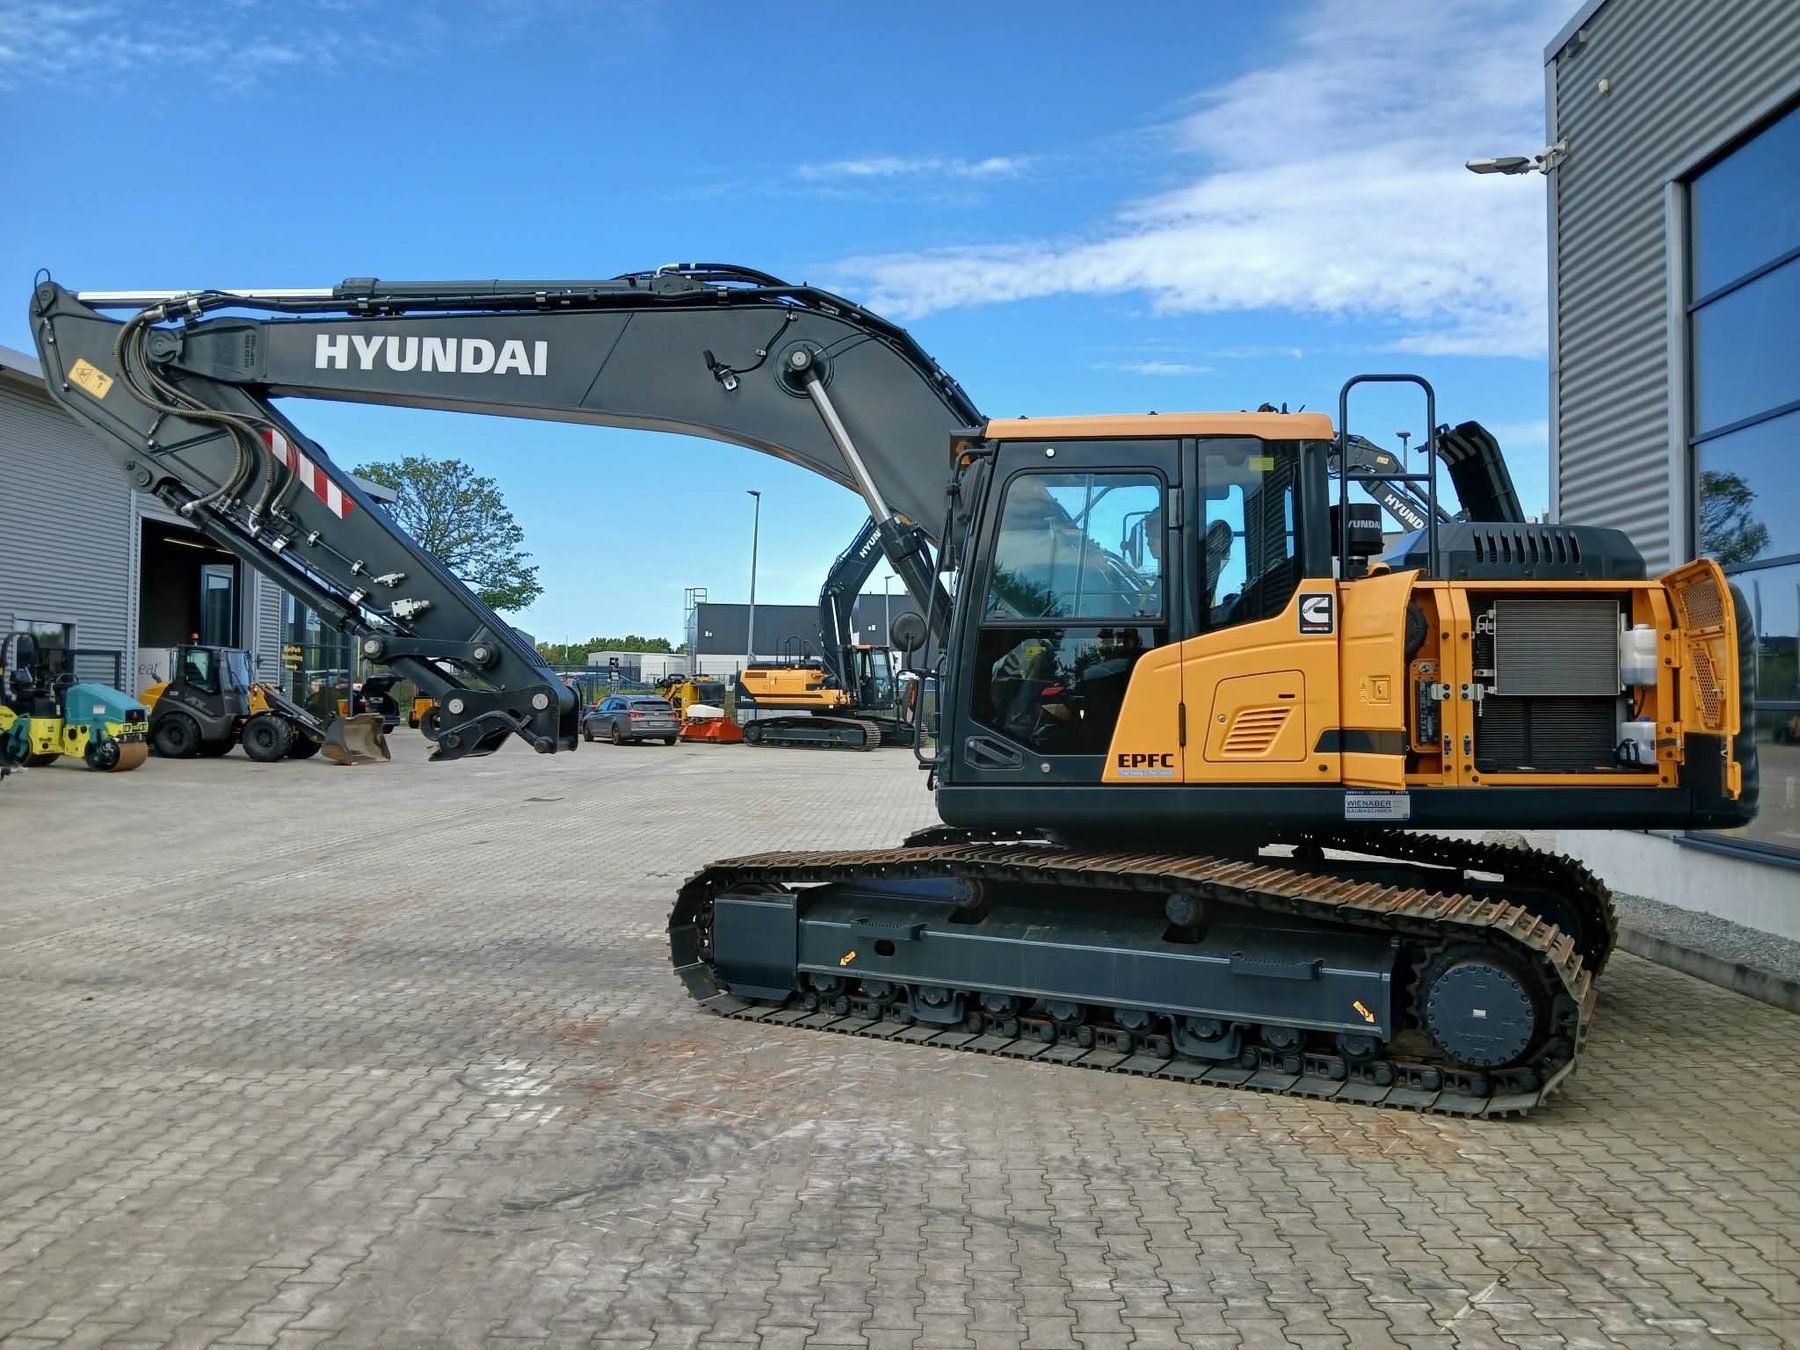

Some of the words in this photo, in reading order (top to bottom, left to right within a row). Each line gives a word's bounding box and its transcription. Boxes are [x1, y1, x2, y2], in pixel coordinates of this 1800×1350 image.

[315, 334, 548, 376] HYUNDAI
[1384, 494, 1425, 530] HYUND
[859, 527, 882, 559] HYUN
[1118, 753, 1175, 768] EPFC
